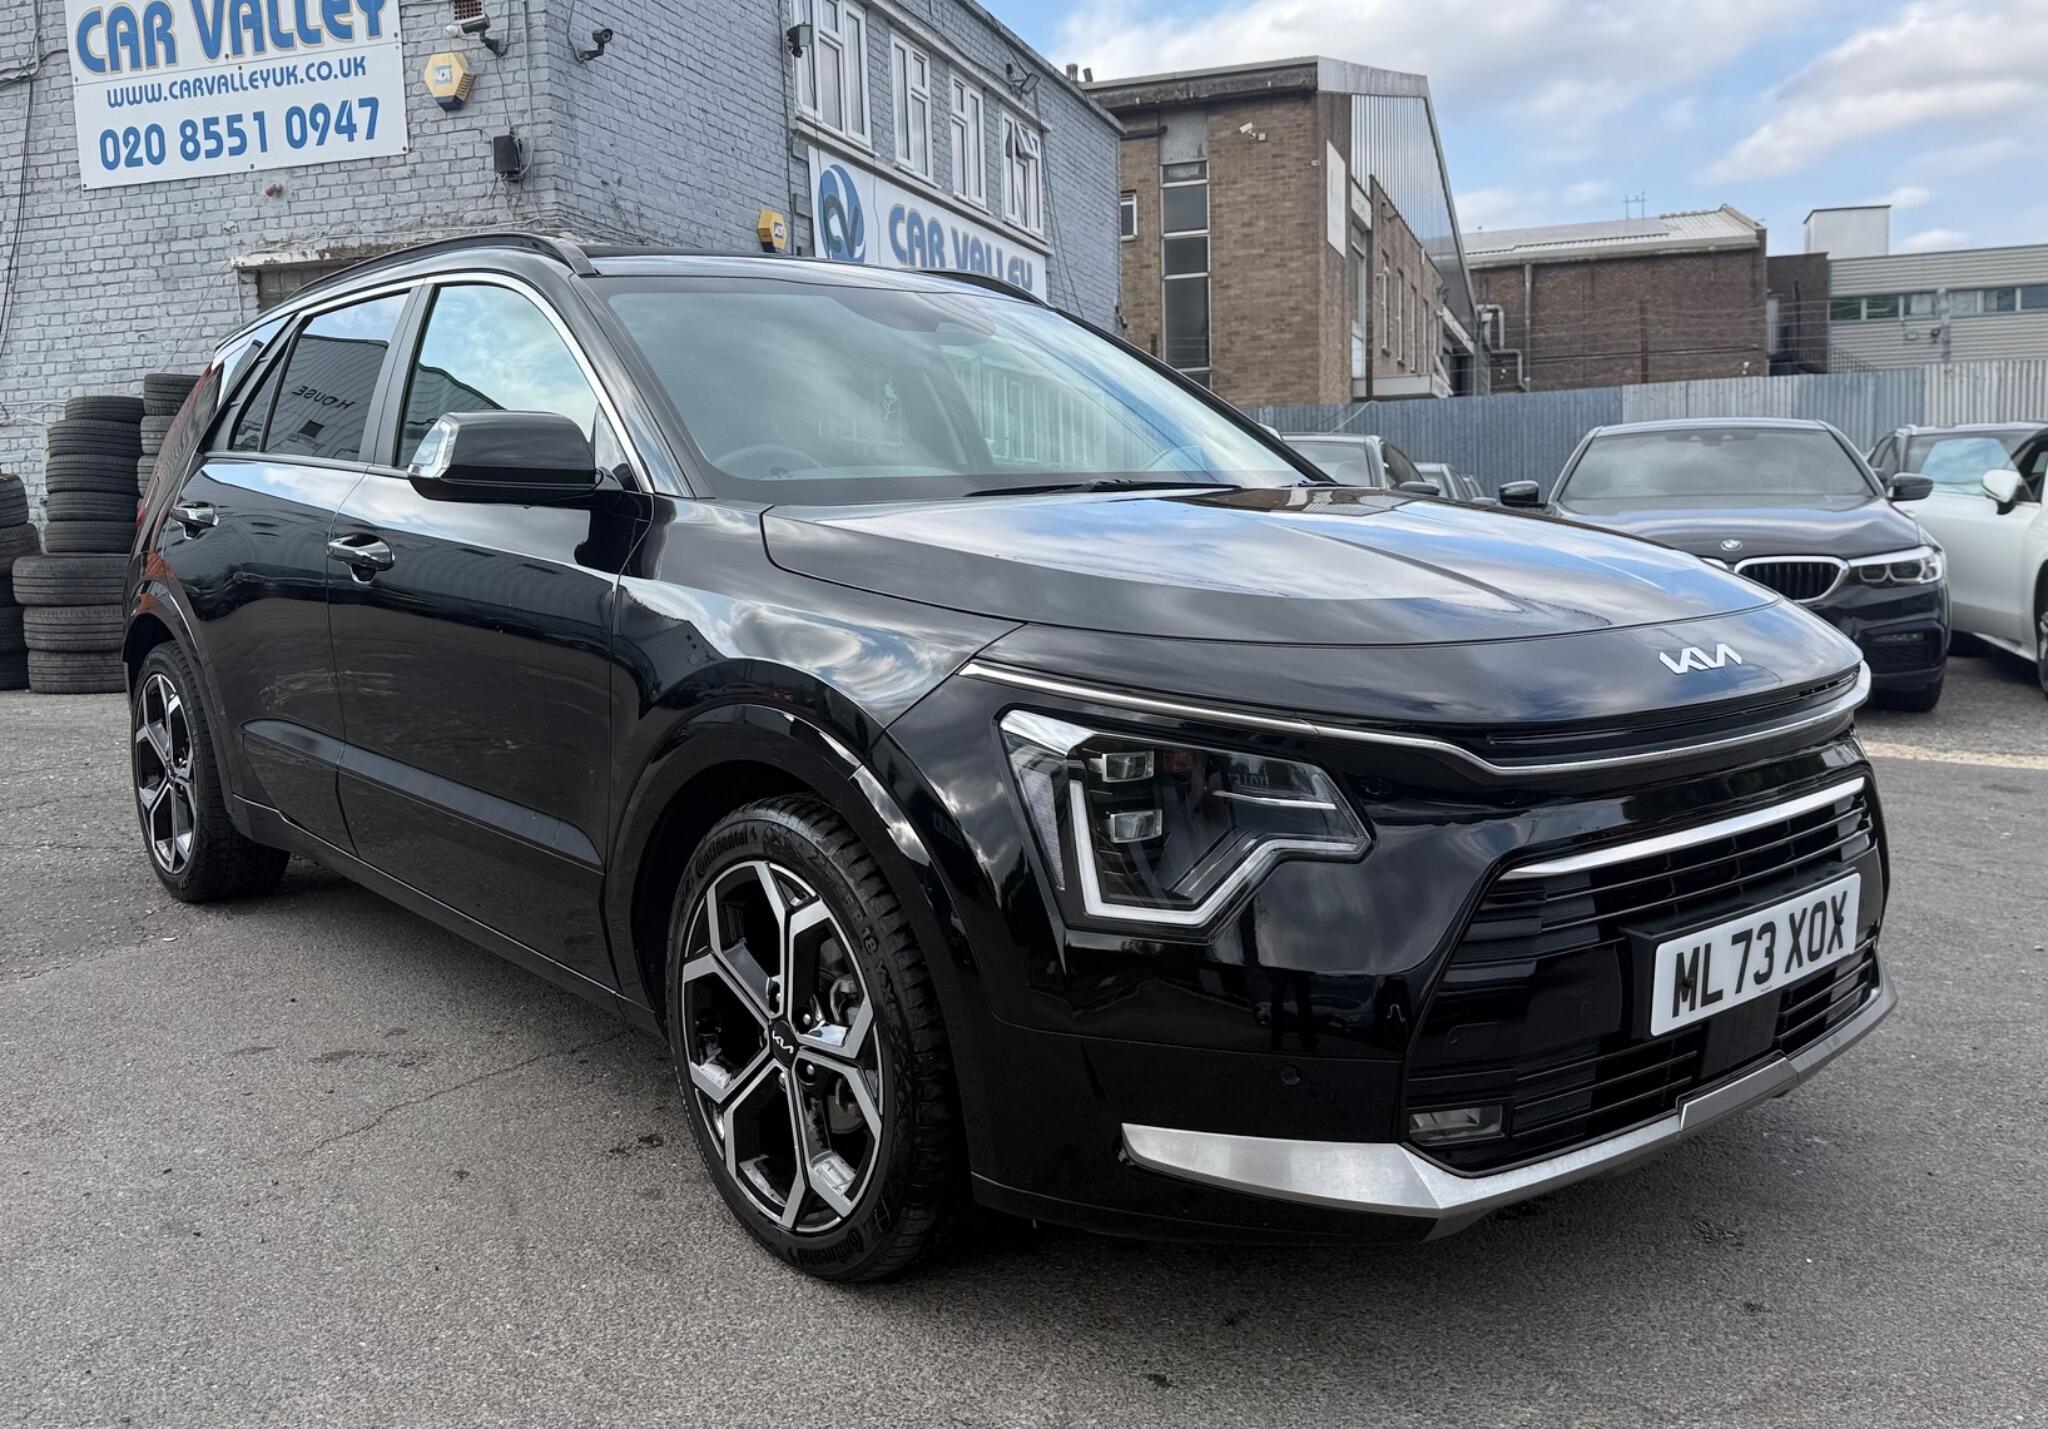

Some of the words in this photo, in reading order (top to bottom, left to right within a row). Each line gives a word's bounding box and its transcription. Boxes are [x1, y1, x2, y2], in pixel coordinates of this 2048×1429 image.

[76, 1, 179, 74] CAR
[107, 56, 366, 108] WWW.CARVALLEYUK.CO.UK
[99, 123, 166, 171] 020
[179, 111, 268, 162] 8551
[285, 97, 379, 149] 0947
[888, 203, 946, 268] CAR
[1658, 643, 1742, 675] KIA
[1671, 921, 1778, 1019] ML73
[1785, 890, 1848, 975] XOX
